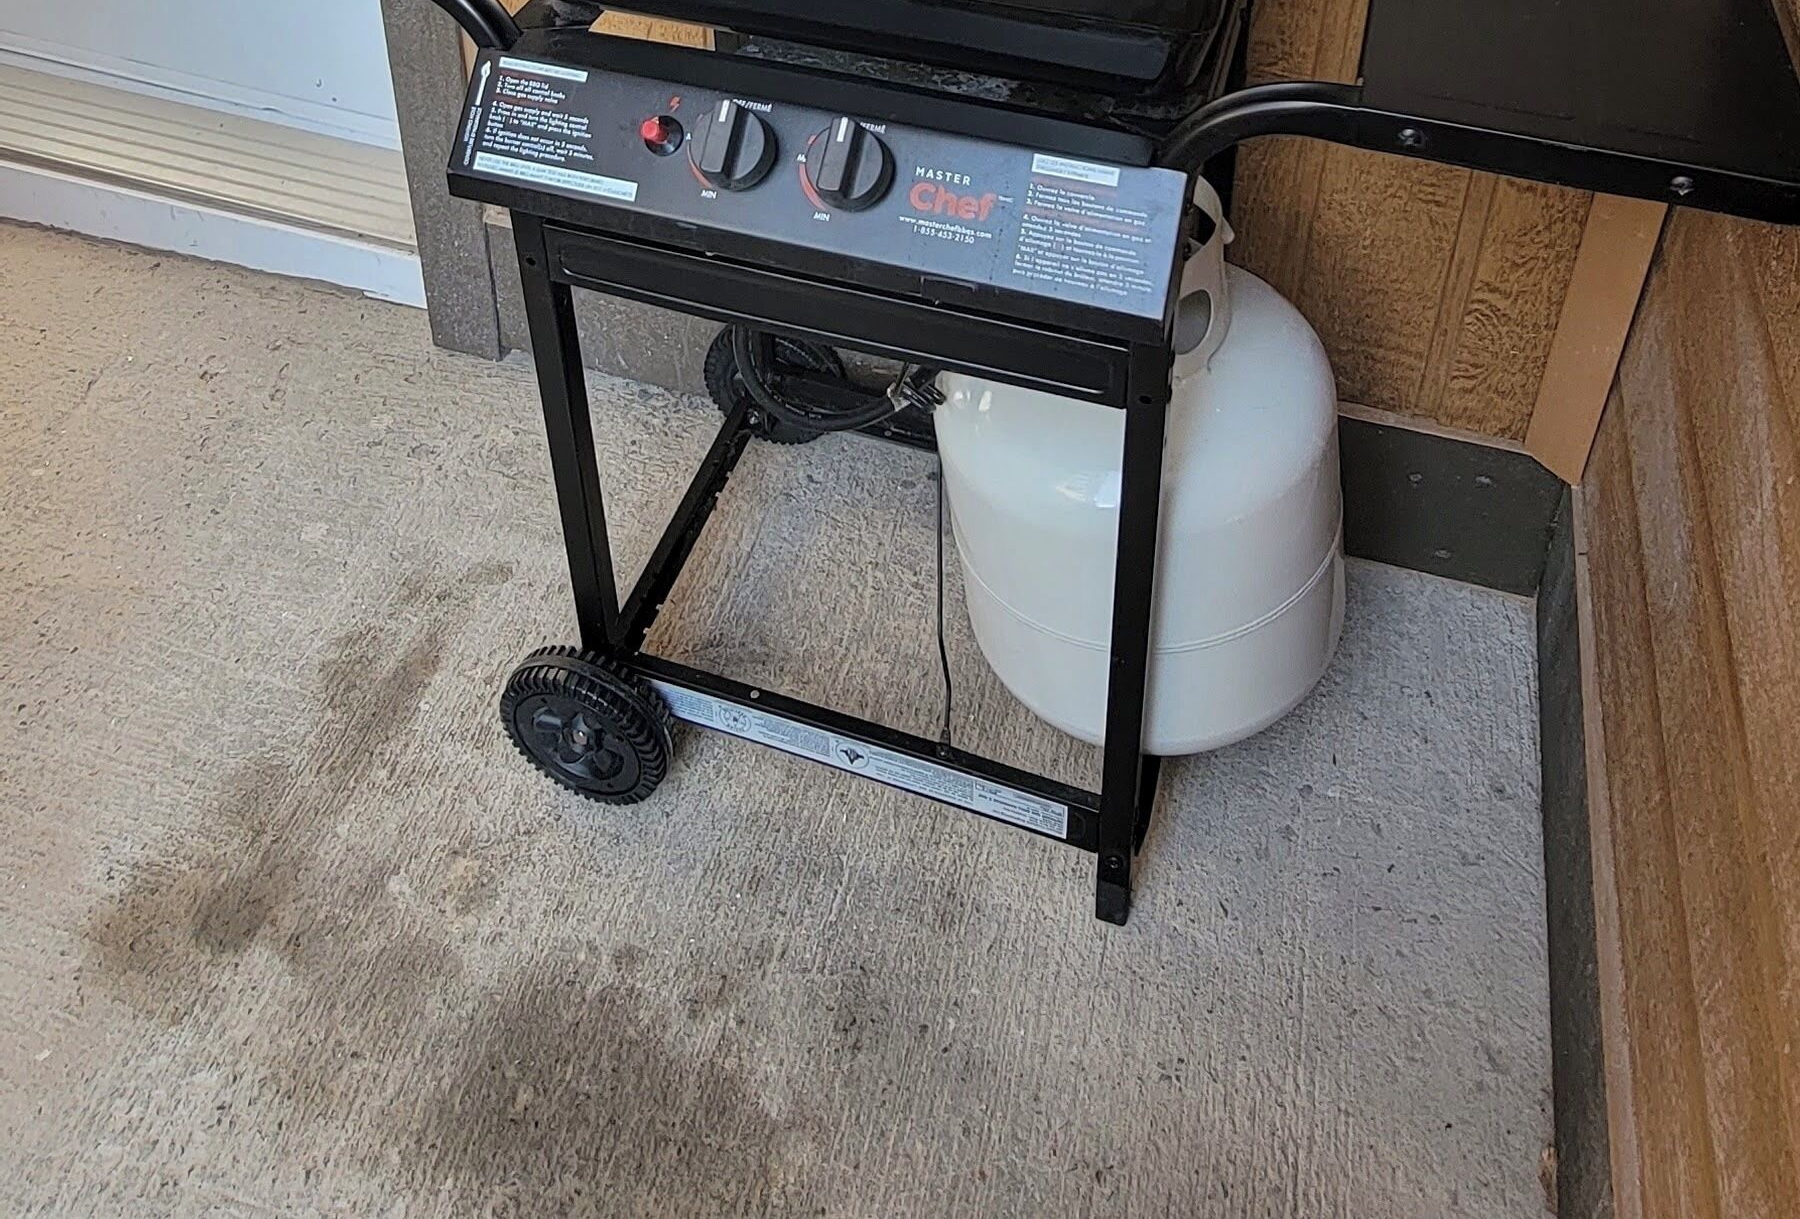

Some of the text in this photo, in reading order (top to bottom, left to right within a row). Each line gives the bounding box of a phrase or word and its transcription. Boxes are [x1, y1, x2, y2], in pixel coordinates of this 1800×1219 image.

[915, 166, 971, 186] MASTER
[701, 190, 717, 199] MIN
[909, 182, 997, 221] Chef
[814, 212, 830, 222] MIN
[913, 225, 975, 244] 1-855-453-2150
